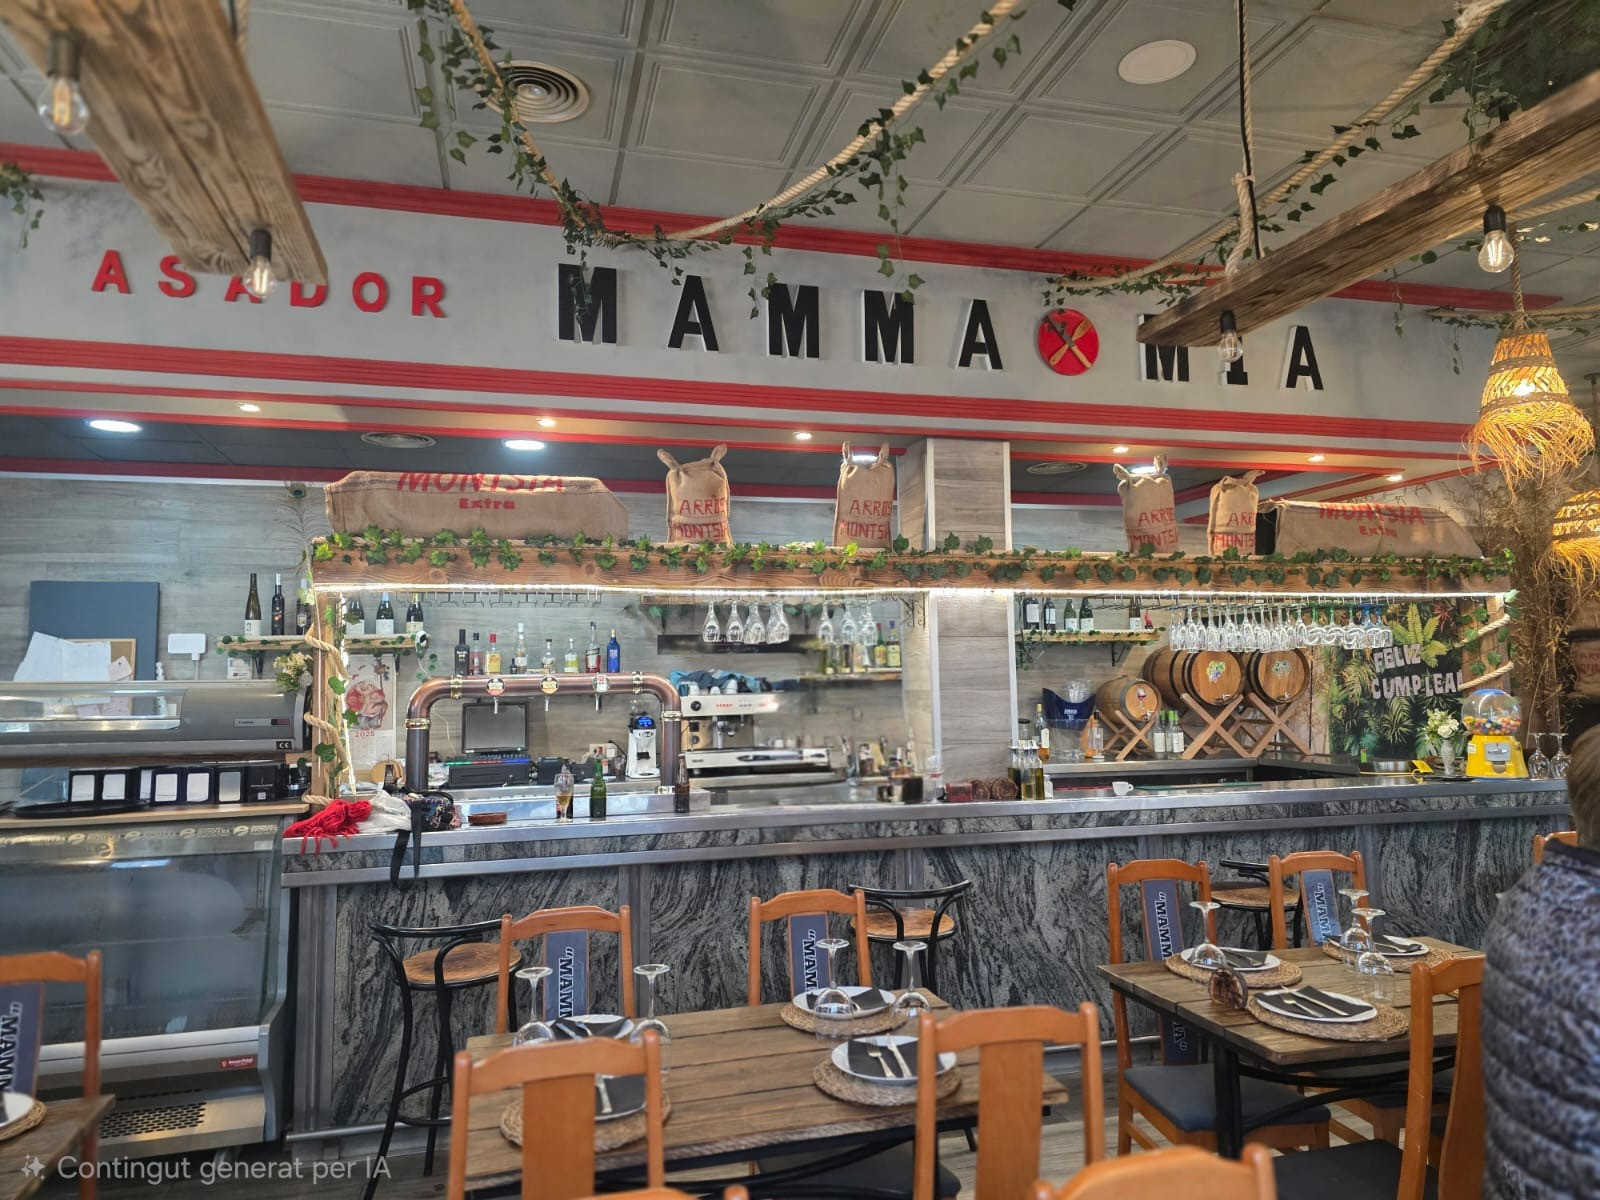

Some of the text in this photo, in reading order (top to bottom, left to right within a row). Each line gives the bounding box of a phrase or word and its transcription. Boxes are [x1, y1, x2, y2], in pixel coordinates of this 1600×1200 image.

[556, 262, 1004, 370] MAMMA
[459, 498, 515, 510] Extra
[1373, 644, 1421, 673] FELIZ
